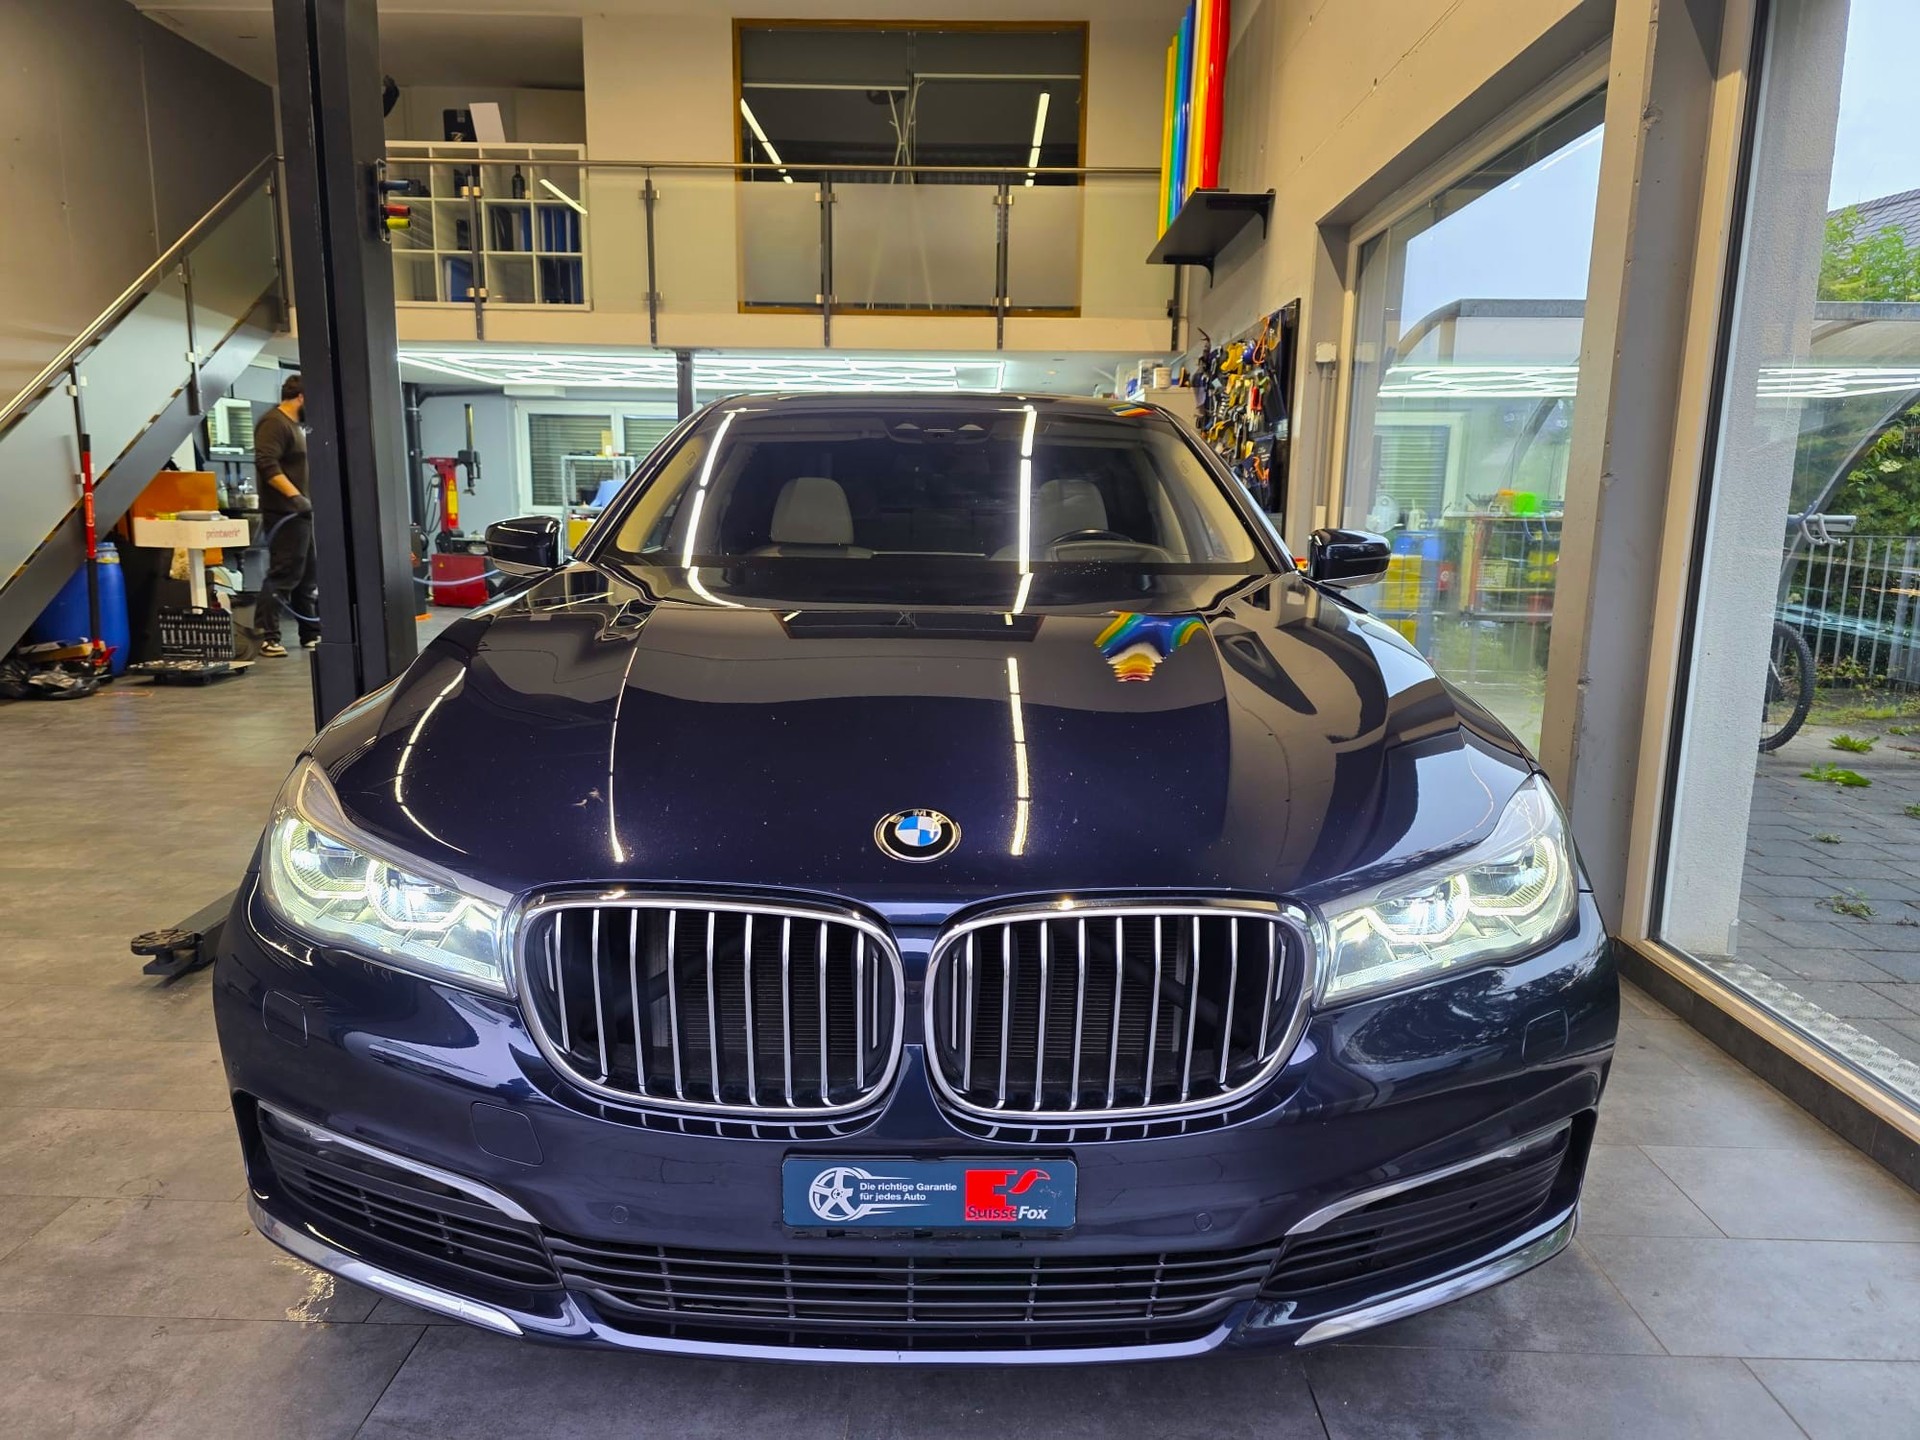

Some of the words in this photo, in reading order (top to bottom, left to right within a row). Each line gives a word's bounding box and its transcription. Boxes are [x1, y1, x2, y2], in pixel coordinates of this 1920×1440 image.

[859, 1182, 876, 1191] Die
[878, 1182, 914, 1192] richtige
[916, 1182, 957, 1191] Garantie
[859, 1192, 873, 1201] für
[875, 1192, 902, 1202] jedes
[903, 1192, 926, 1201] Auto
